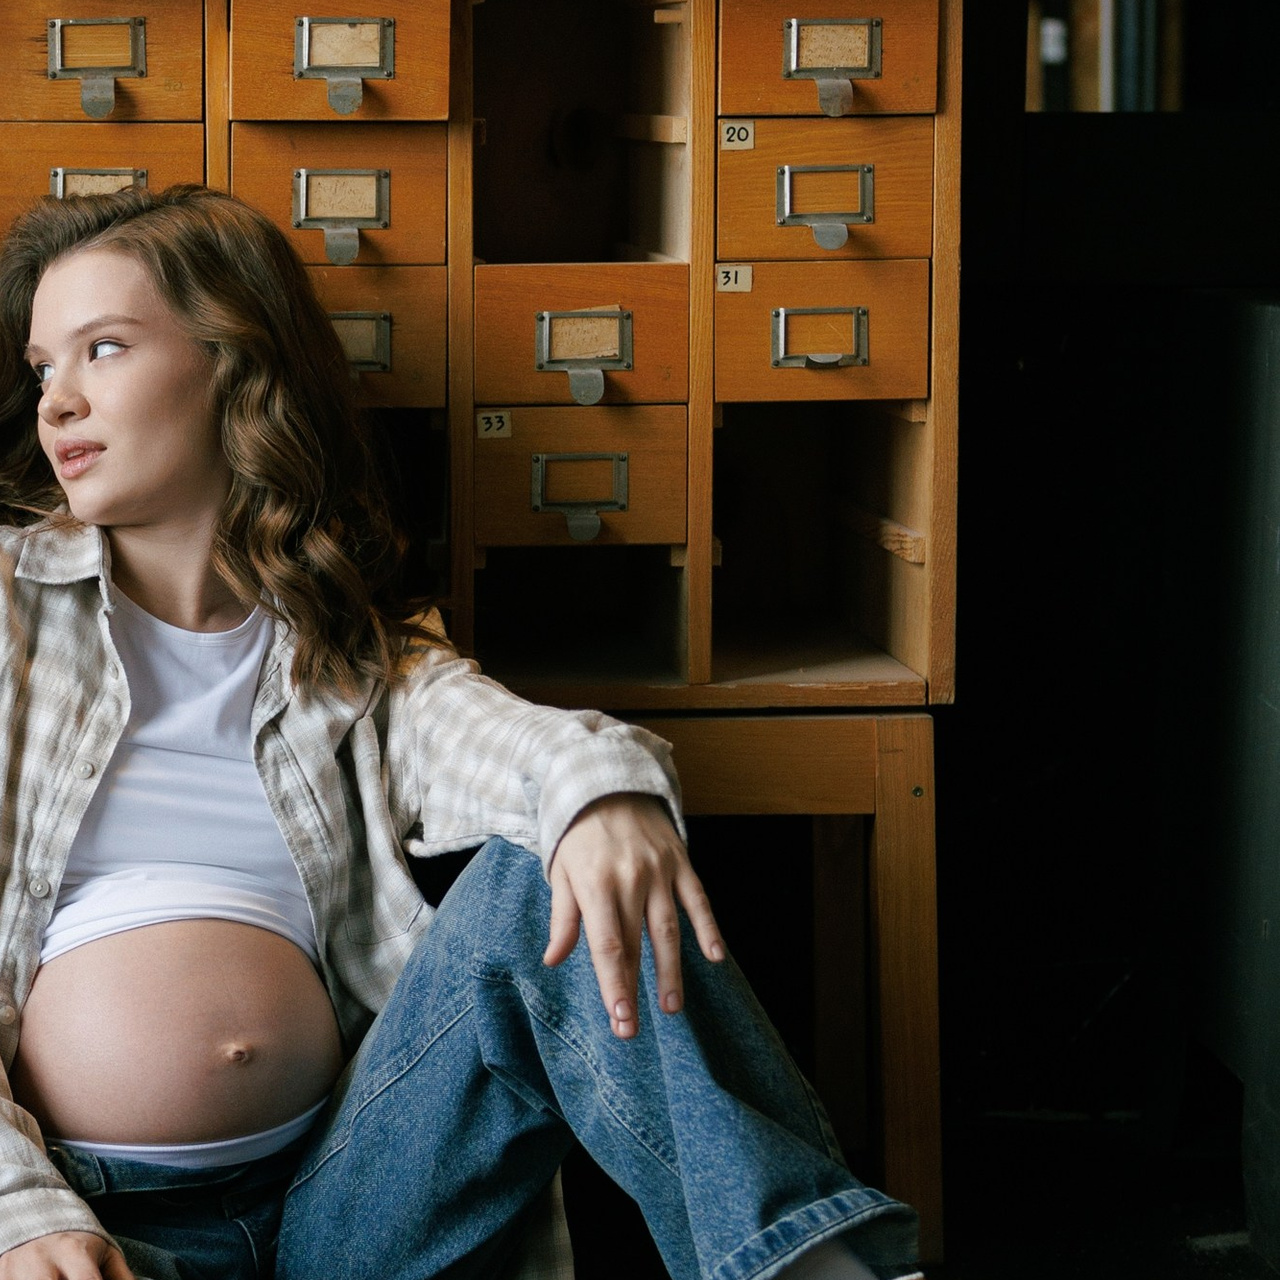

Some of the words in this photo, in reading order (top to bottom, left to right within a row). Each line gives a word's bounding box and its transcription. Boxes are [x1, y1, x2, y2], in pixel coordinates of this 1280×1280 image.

[726, 126, 749, 143] 20
[721, 270, 739, 286] 31
[481, 415, 505, 432] 33
